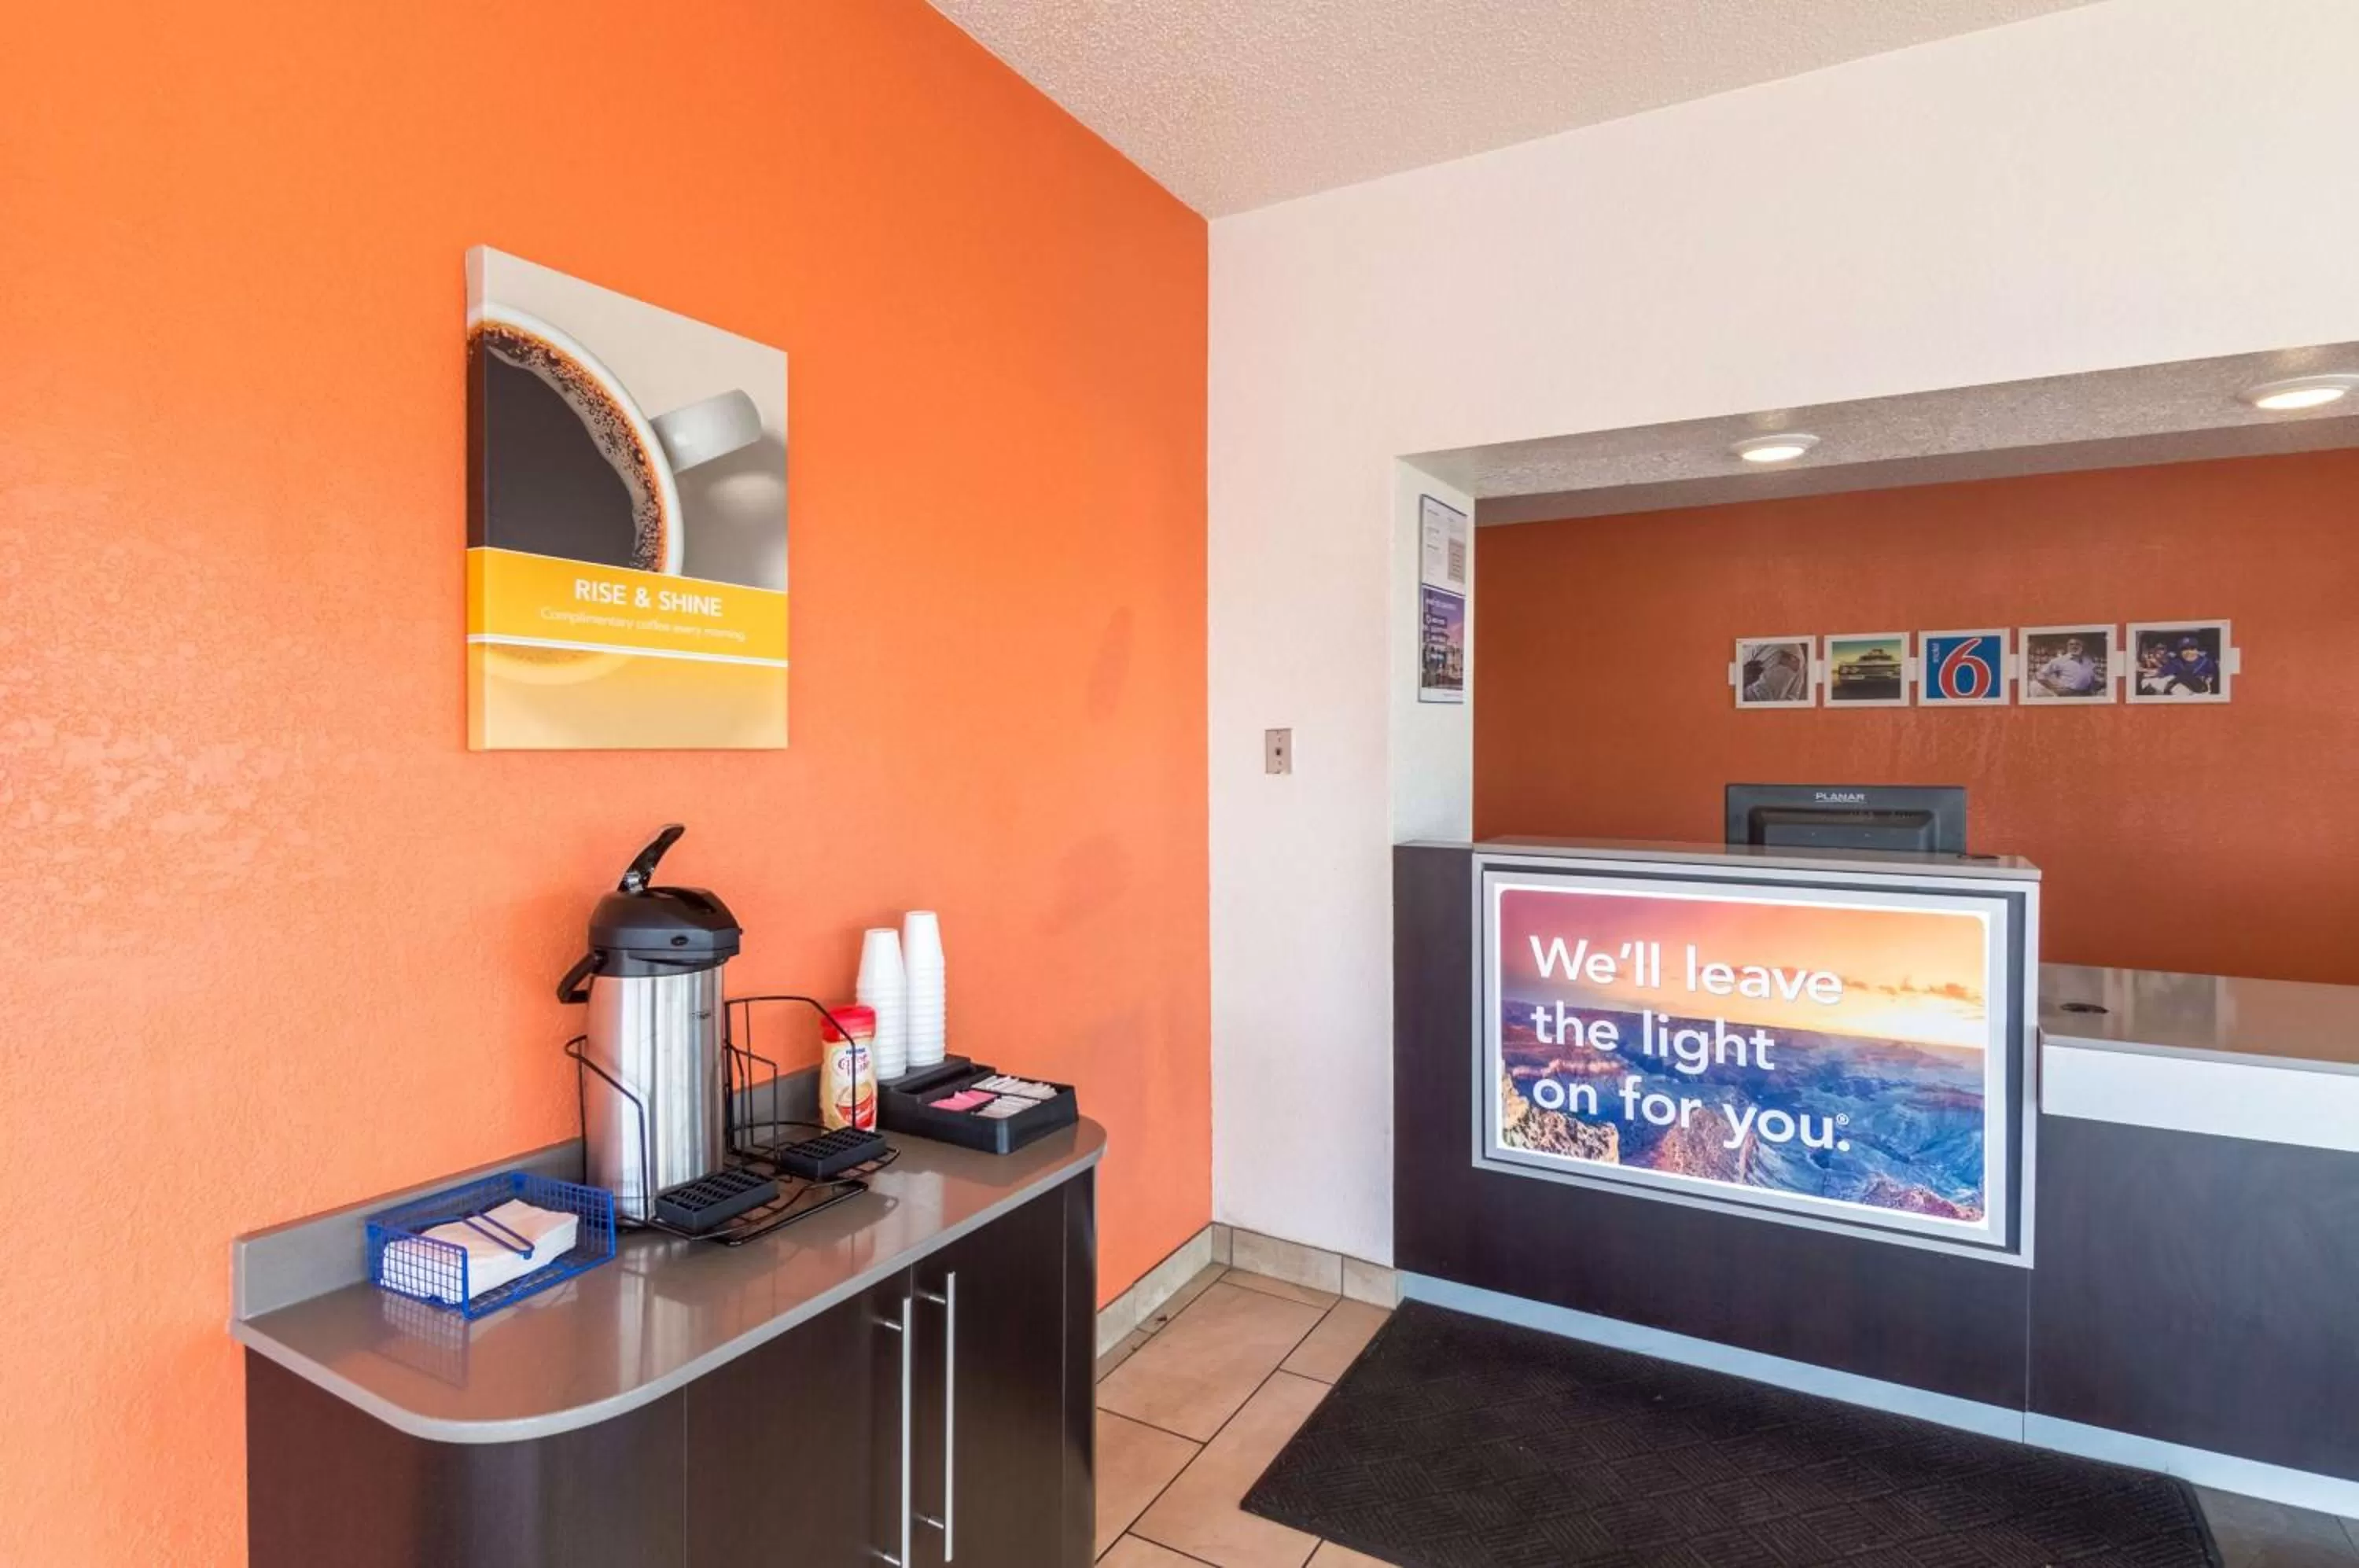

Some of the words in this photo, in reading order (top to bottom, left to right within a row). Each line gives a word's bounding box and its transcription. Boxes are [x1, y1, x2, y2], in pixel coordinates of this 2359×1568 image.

[540, 606, 635, 630] Complimentary
[575, 578, 627, 605] RISE
[635, 587, 651, 608] &
[658, 591, 723, 617] SHINE
[1938, 638, 1992, 699] 6
[1814, 792, 1865, 801] PLANAR
[1686, 944, 1843, 1004] leave
[1530, 1000, 1620, 1051] the
[1643, 1009, 1776, 1075] light
[1533, 1077, 1598, 1116] on
[1619, 1075, 1702, 1129] for
